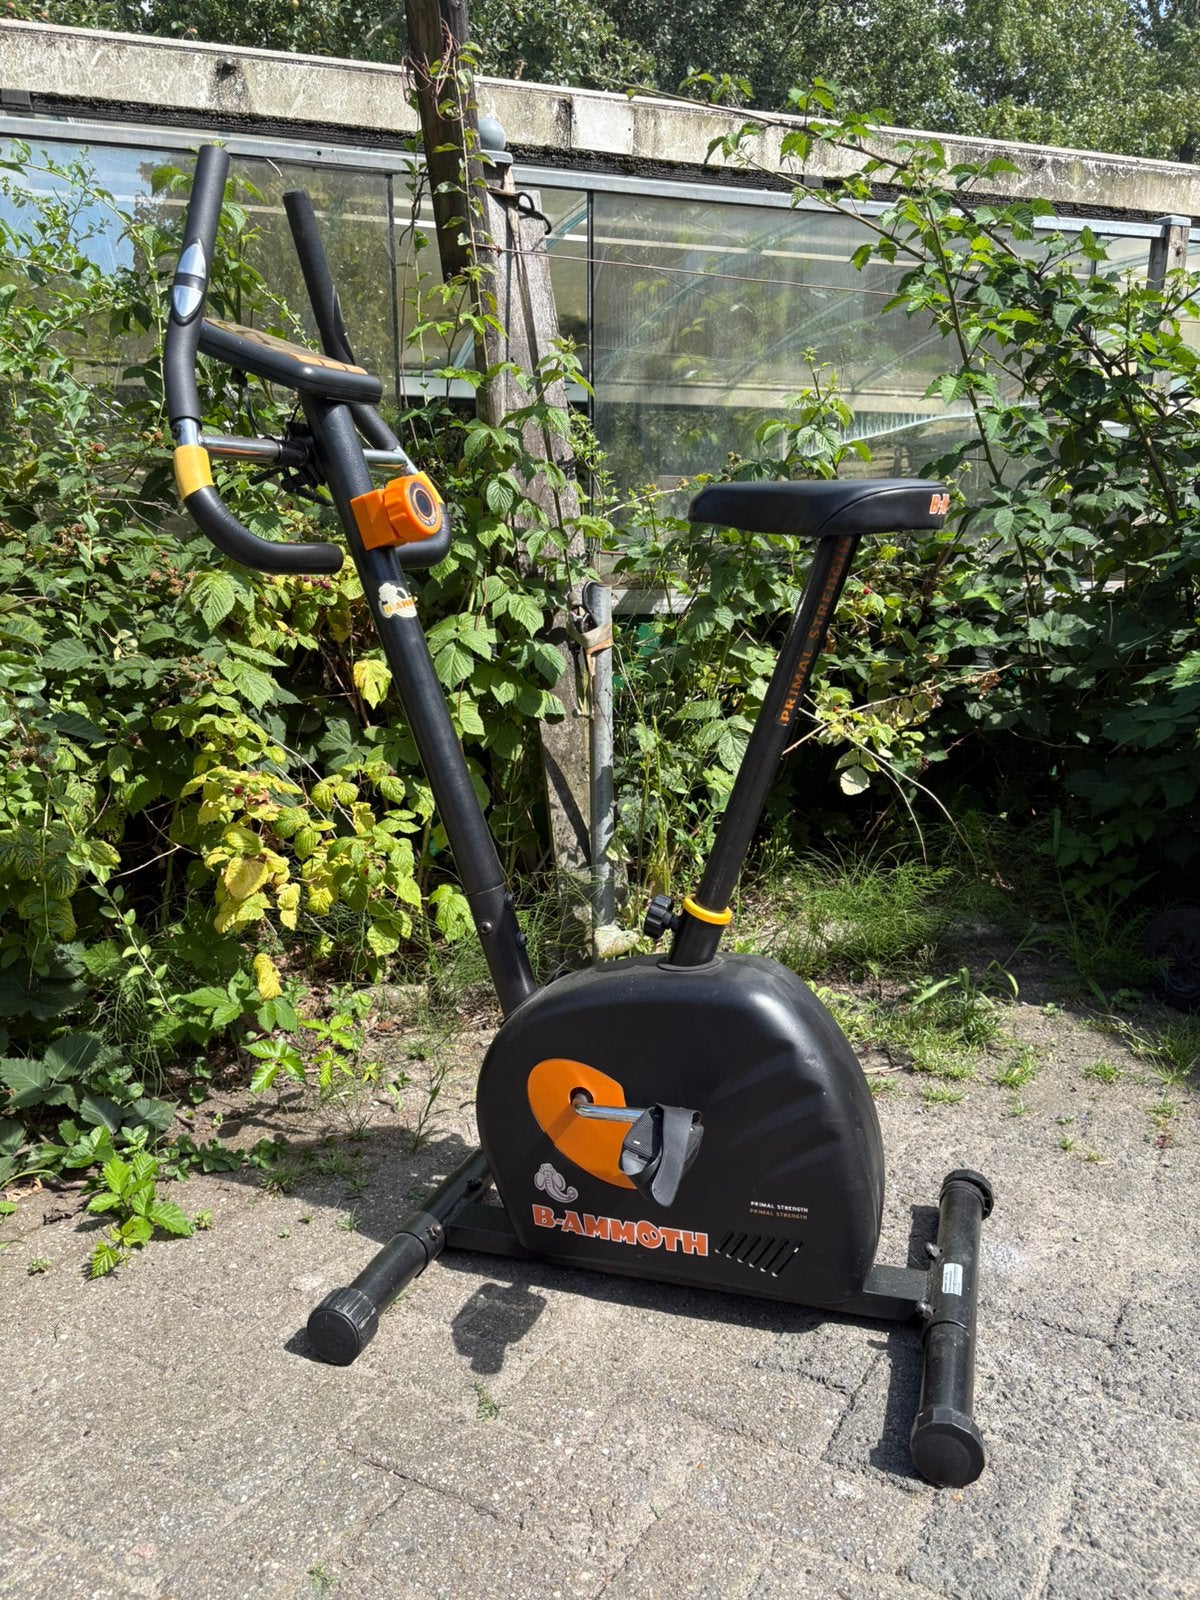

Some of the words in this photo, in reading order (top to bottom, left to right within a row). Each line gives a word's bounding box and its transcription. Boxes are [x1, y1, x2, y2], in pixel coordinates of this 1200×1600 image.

[780, 650, 813, 722] PRIMAL
[749, 1208, 774, 1217] PRIMAL
[776, 1212, 808, 1220] STRENGTH
[750, 1200, 775, 1209] PRIMAL
[776, 1204, 809, 1213] STRENGTH
[531, 1203, 708, 1257] B-AMMOTH
